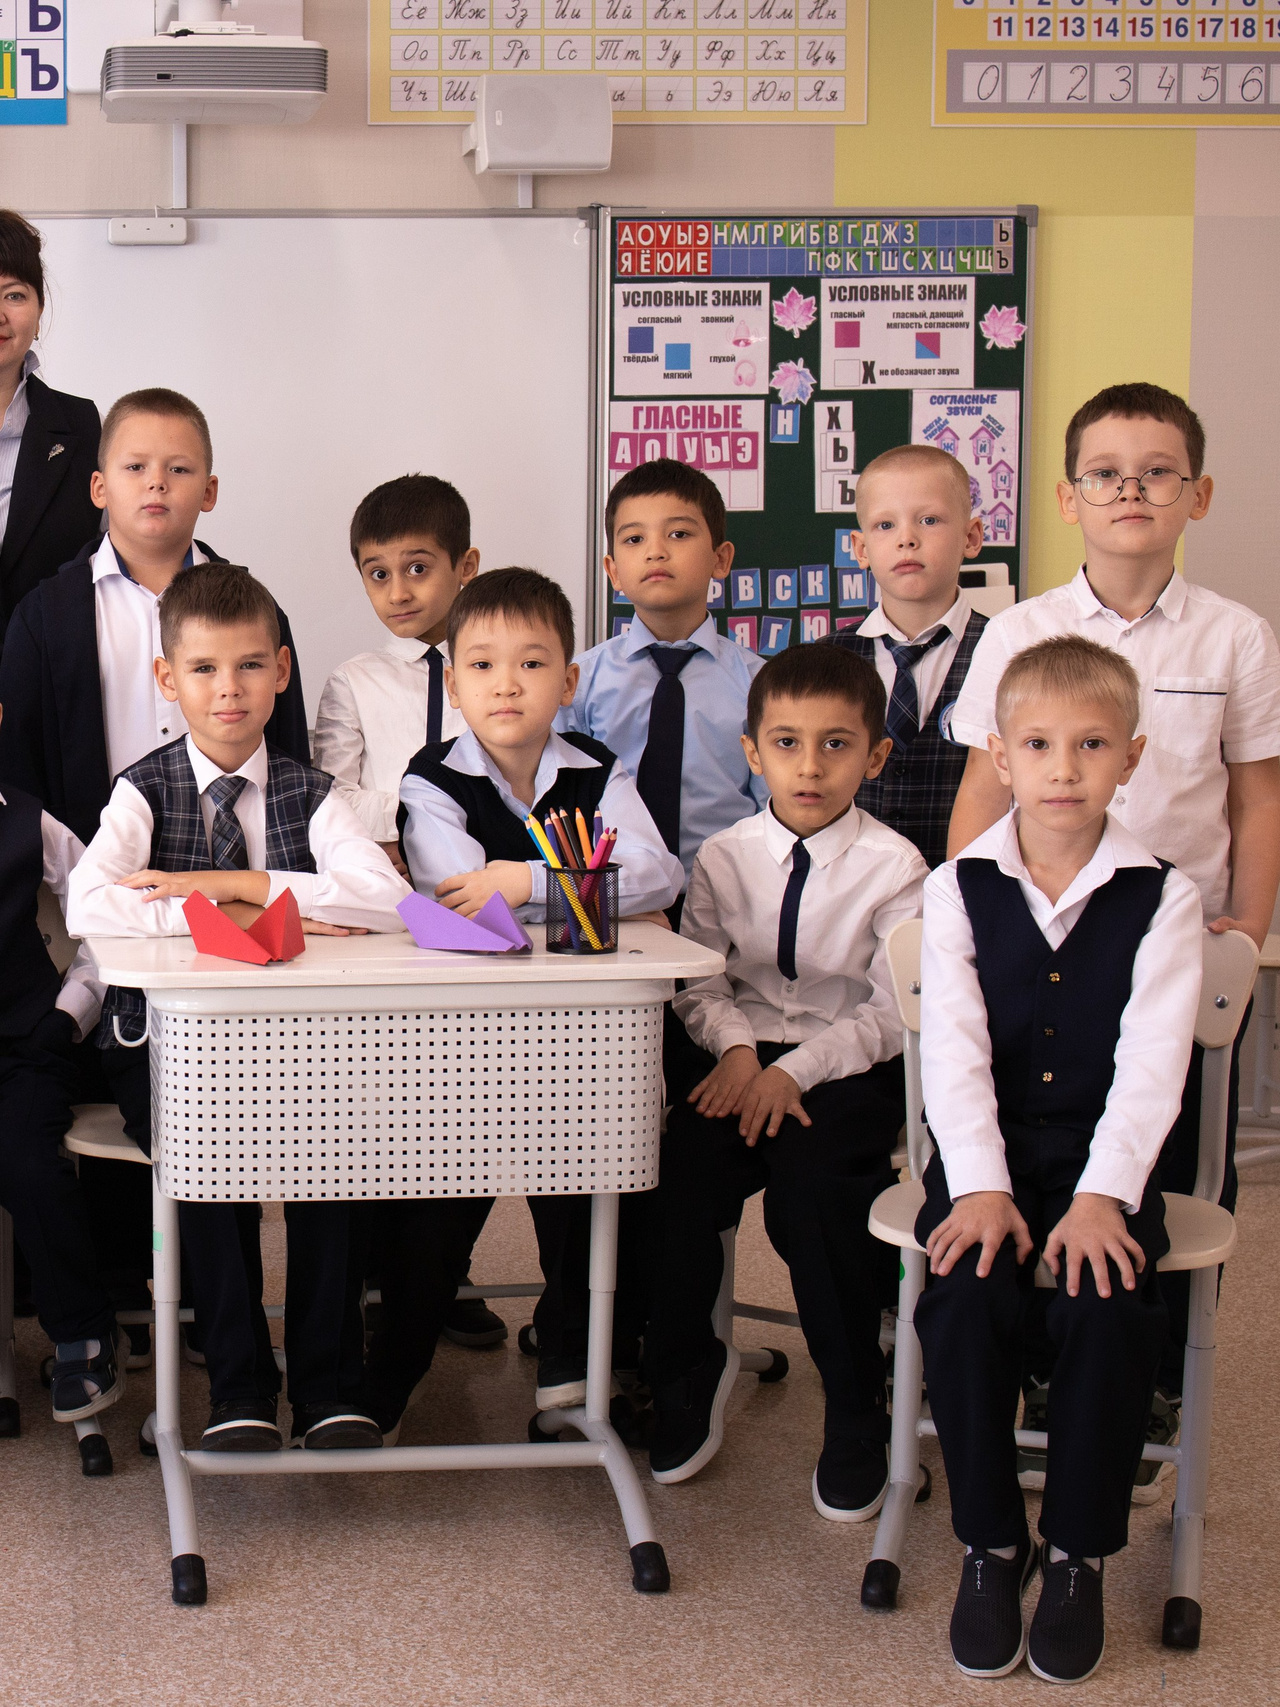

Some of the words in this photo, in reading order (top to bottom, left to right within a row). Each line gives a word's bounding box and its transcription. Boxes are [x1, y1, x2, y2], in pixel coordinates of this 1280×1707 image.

[992, 16, 1013, 37] 11
[1024, 17, 1052, 37] 12
[1059, 17, 1085, 38] 13
[1093, 17, 1119, 38] 14
[1127, 17, 1154, 38] 15
[1162, 17, 1189, 38] 16
[1197, 17, 1224, 38] 17
[1230, 17, 1256, 38] 18
[977, 64, 1000, 101] 0
[1027, 64, 1044, 101] 1
[1066, 65, 1089, 101] 2
[1109, 65, 1132, 101] 3
[1157, 65, 1176, 101] 4
[1197, 66, 1220, 101] 5
[1240, 66, 1264, 102] 6
[622, 290, 708, 307] УСЛОВНЫЕ
[711, 290, 762, 306] ЗНАКИ
[828, 285, 914, 302] УСЛОВНЫЕ
[917, 284, 967, 301] ЗНАКИ
[930, 394, 998, 405] СОГЛАСНЫЕ
[632, 405, 742, 430] ГЛАСНЫЕ
[946, 406, 982, 416] ЗВУКИ
